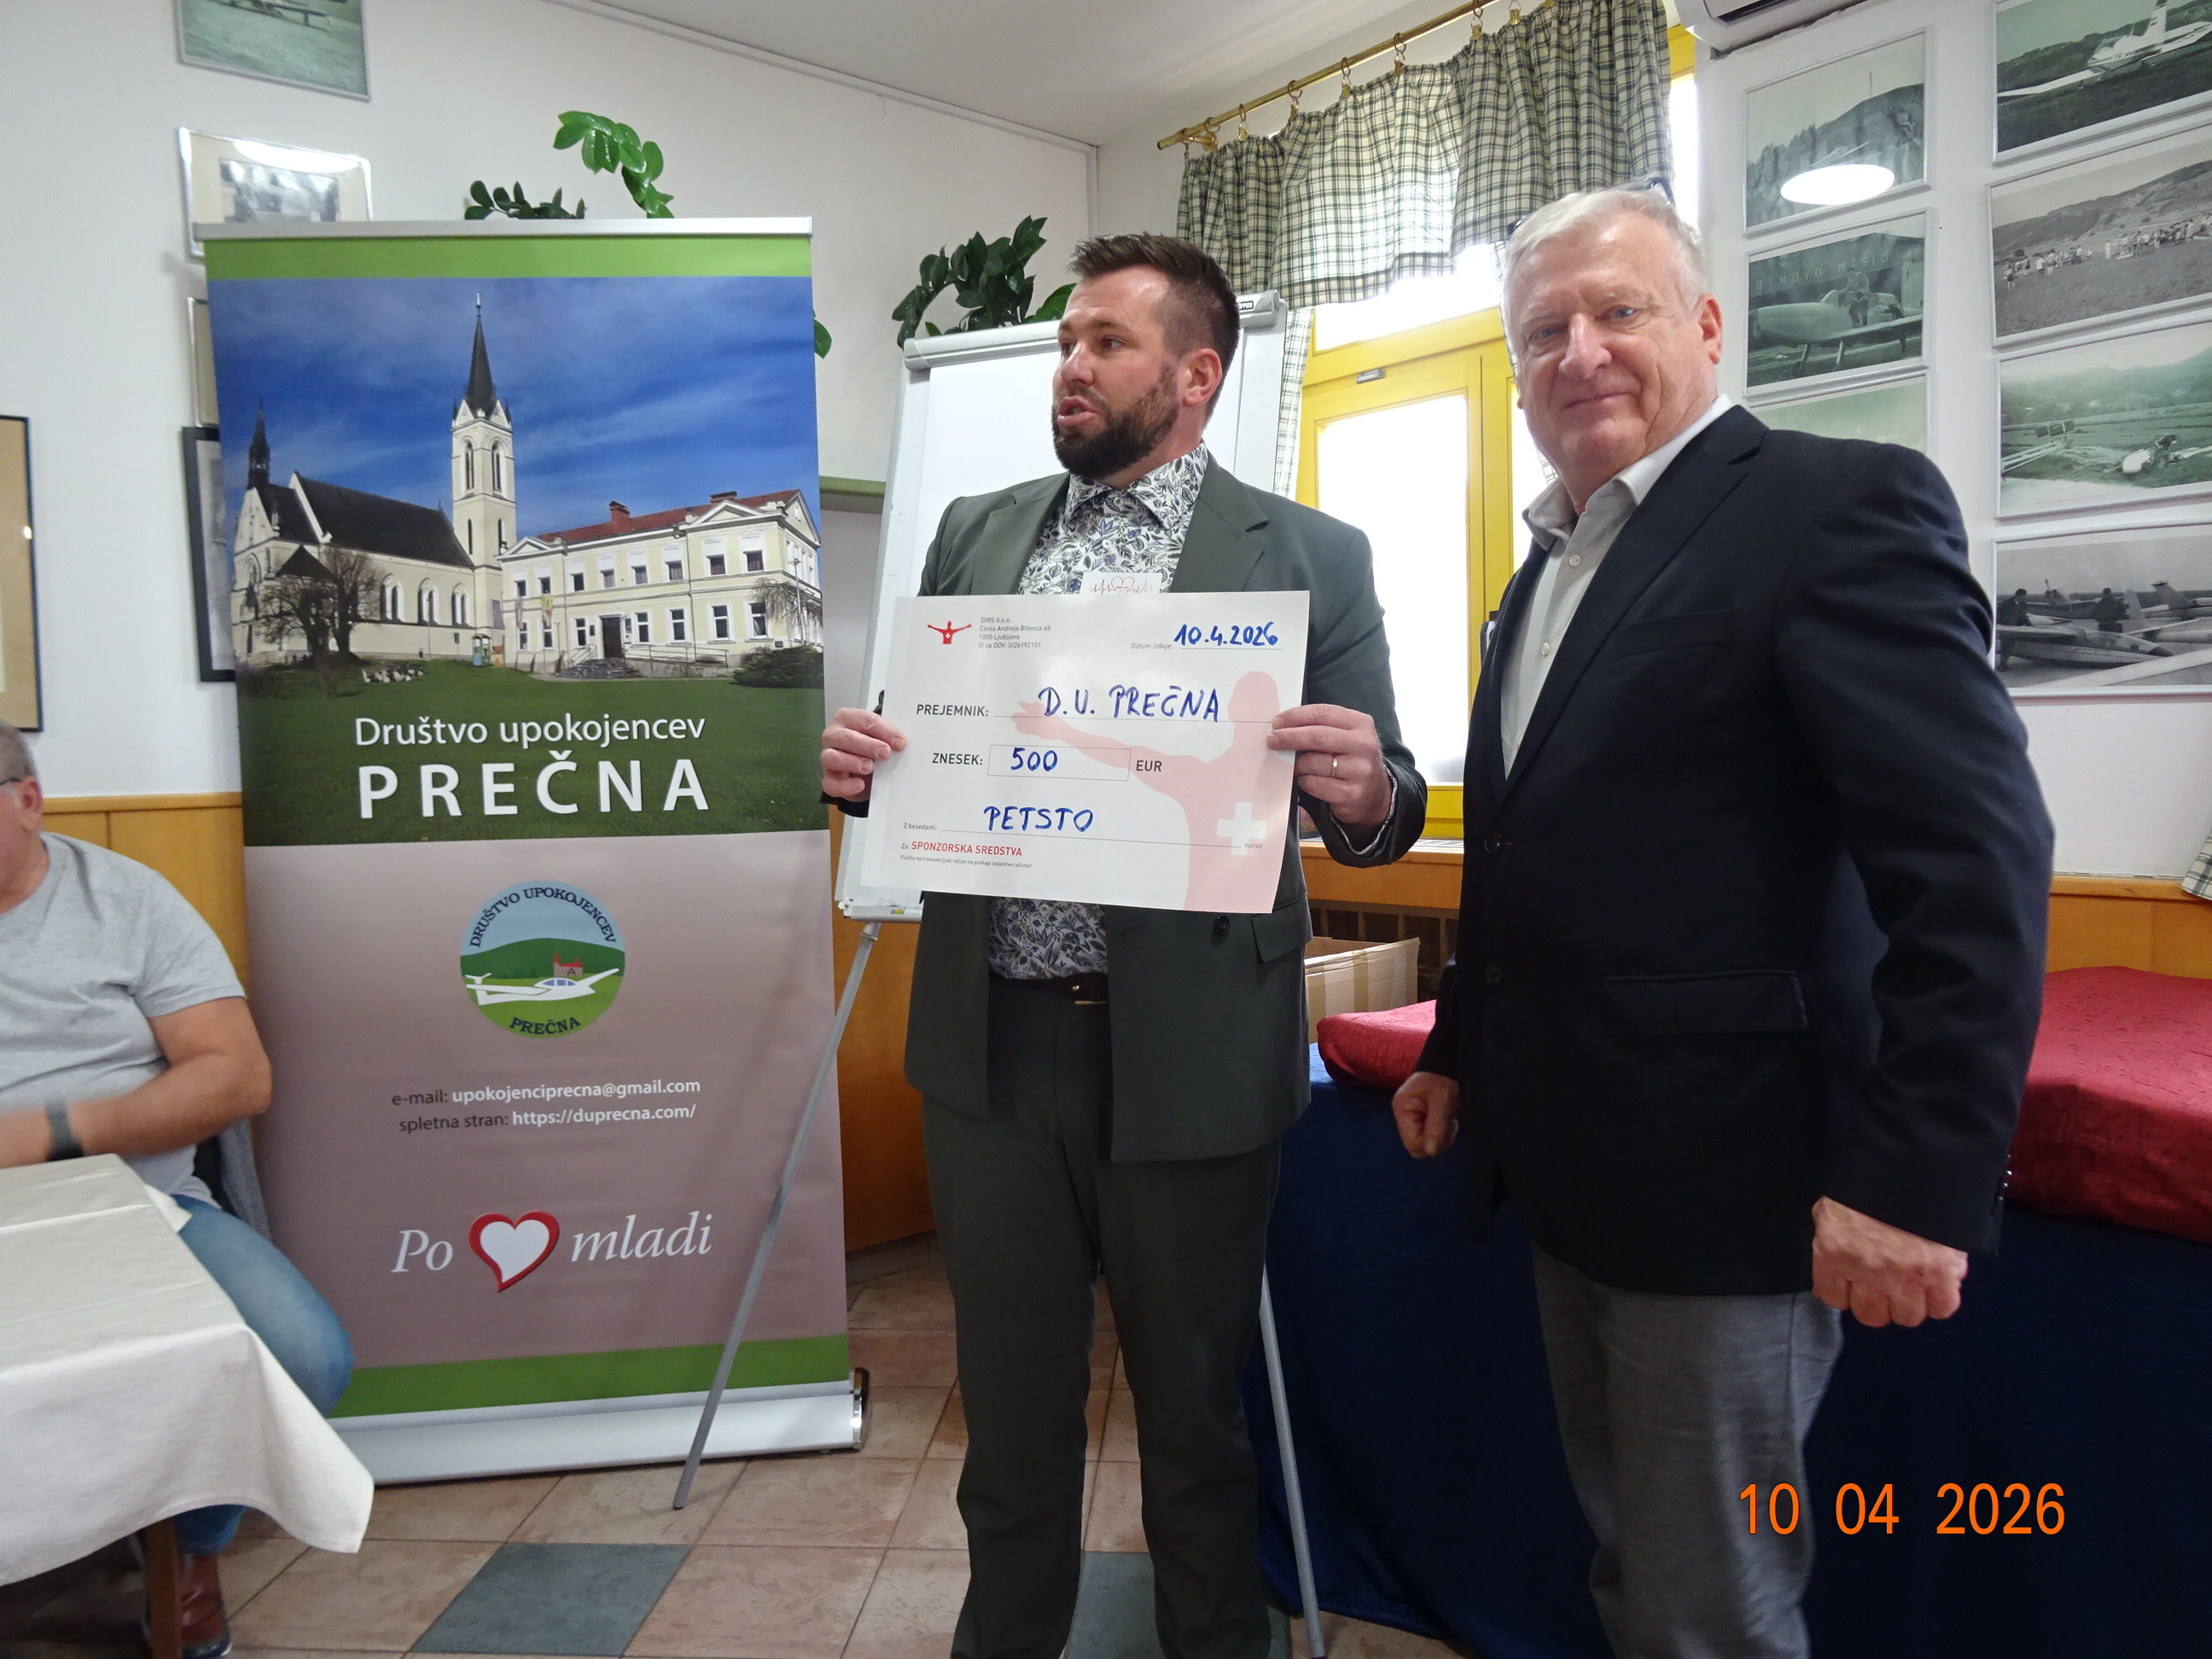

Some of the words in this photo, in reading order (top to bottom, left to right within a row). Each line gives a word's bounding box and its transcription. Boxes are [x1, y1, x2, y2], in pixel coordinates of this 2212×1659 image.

[1778, 266, 1822, 285] NOVO
[993, 633, 1020, 642] Ljubljana
[997, 625, 1020, 633] Andreja
[1173, 621, 1278, 646] 10.4.2026
[1152, 642, 1173, 651] izdaje:
[916, 703, 989, 717] PREJEMNIK:
[1109, 684, 1219, 723] PREČNA
[355, 715, 488, 746] Društvo
[498, 713, 707, 749] upokojencev
[932, 753, 983, 765] ZNESEK:
[1010, 747, 1058, 771] 500
[1136, 760, 1162, 772] EUR
[358, 749, 710, 819] PREČNA
[908, 823, 938, 831] besedami:
[983, 806, 1093, 833] PETSTO
[911, 841, 973, 853] SPONZORSKA
[975, 845, 1022, 857] SREDSTVA
[469, 892, 521, 948] DRUŠTVO
[522, 887, 617, 943] UPOKOJENCEV
[509, 1016, 581, 1035] PREČNA
[392, 1088, 449, 1106] e-mail:
[451, 1079, 701, 1104] upokojenciprecna@gmail.com
[399, 1114, 460, 1133] spletna
[463, 1113, 509, 1127] stran:
[512, 1103, 697, 1128] https://duprecna.com/
[390, 1228, 454, 1273] Po
[569, 1210, 713, 1263] mladi
